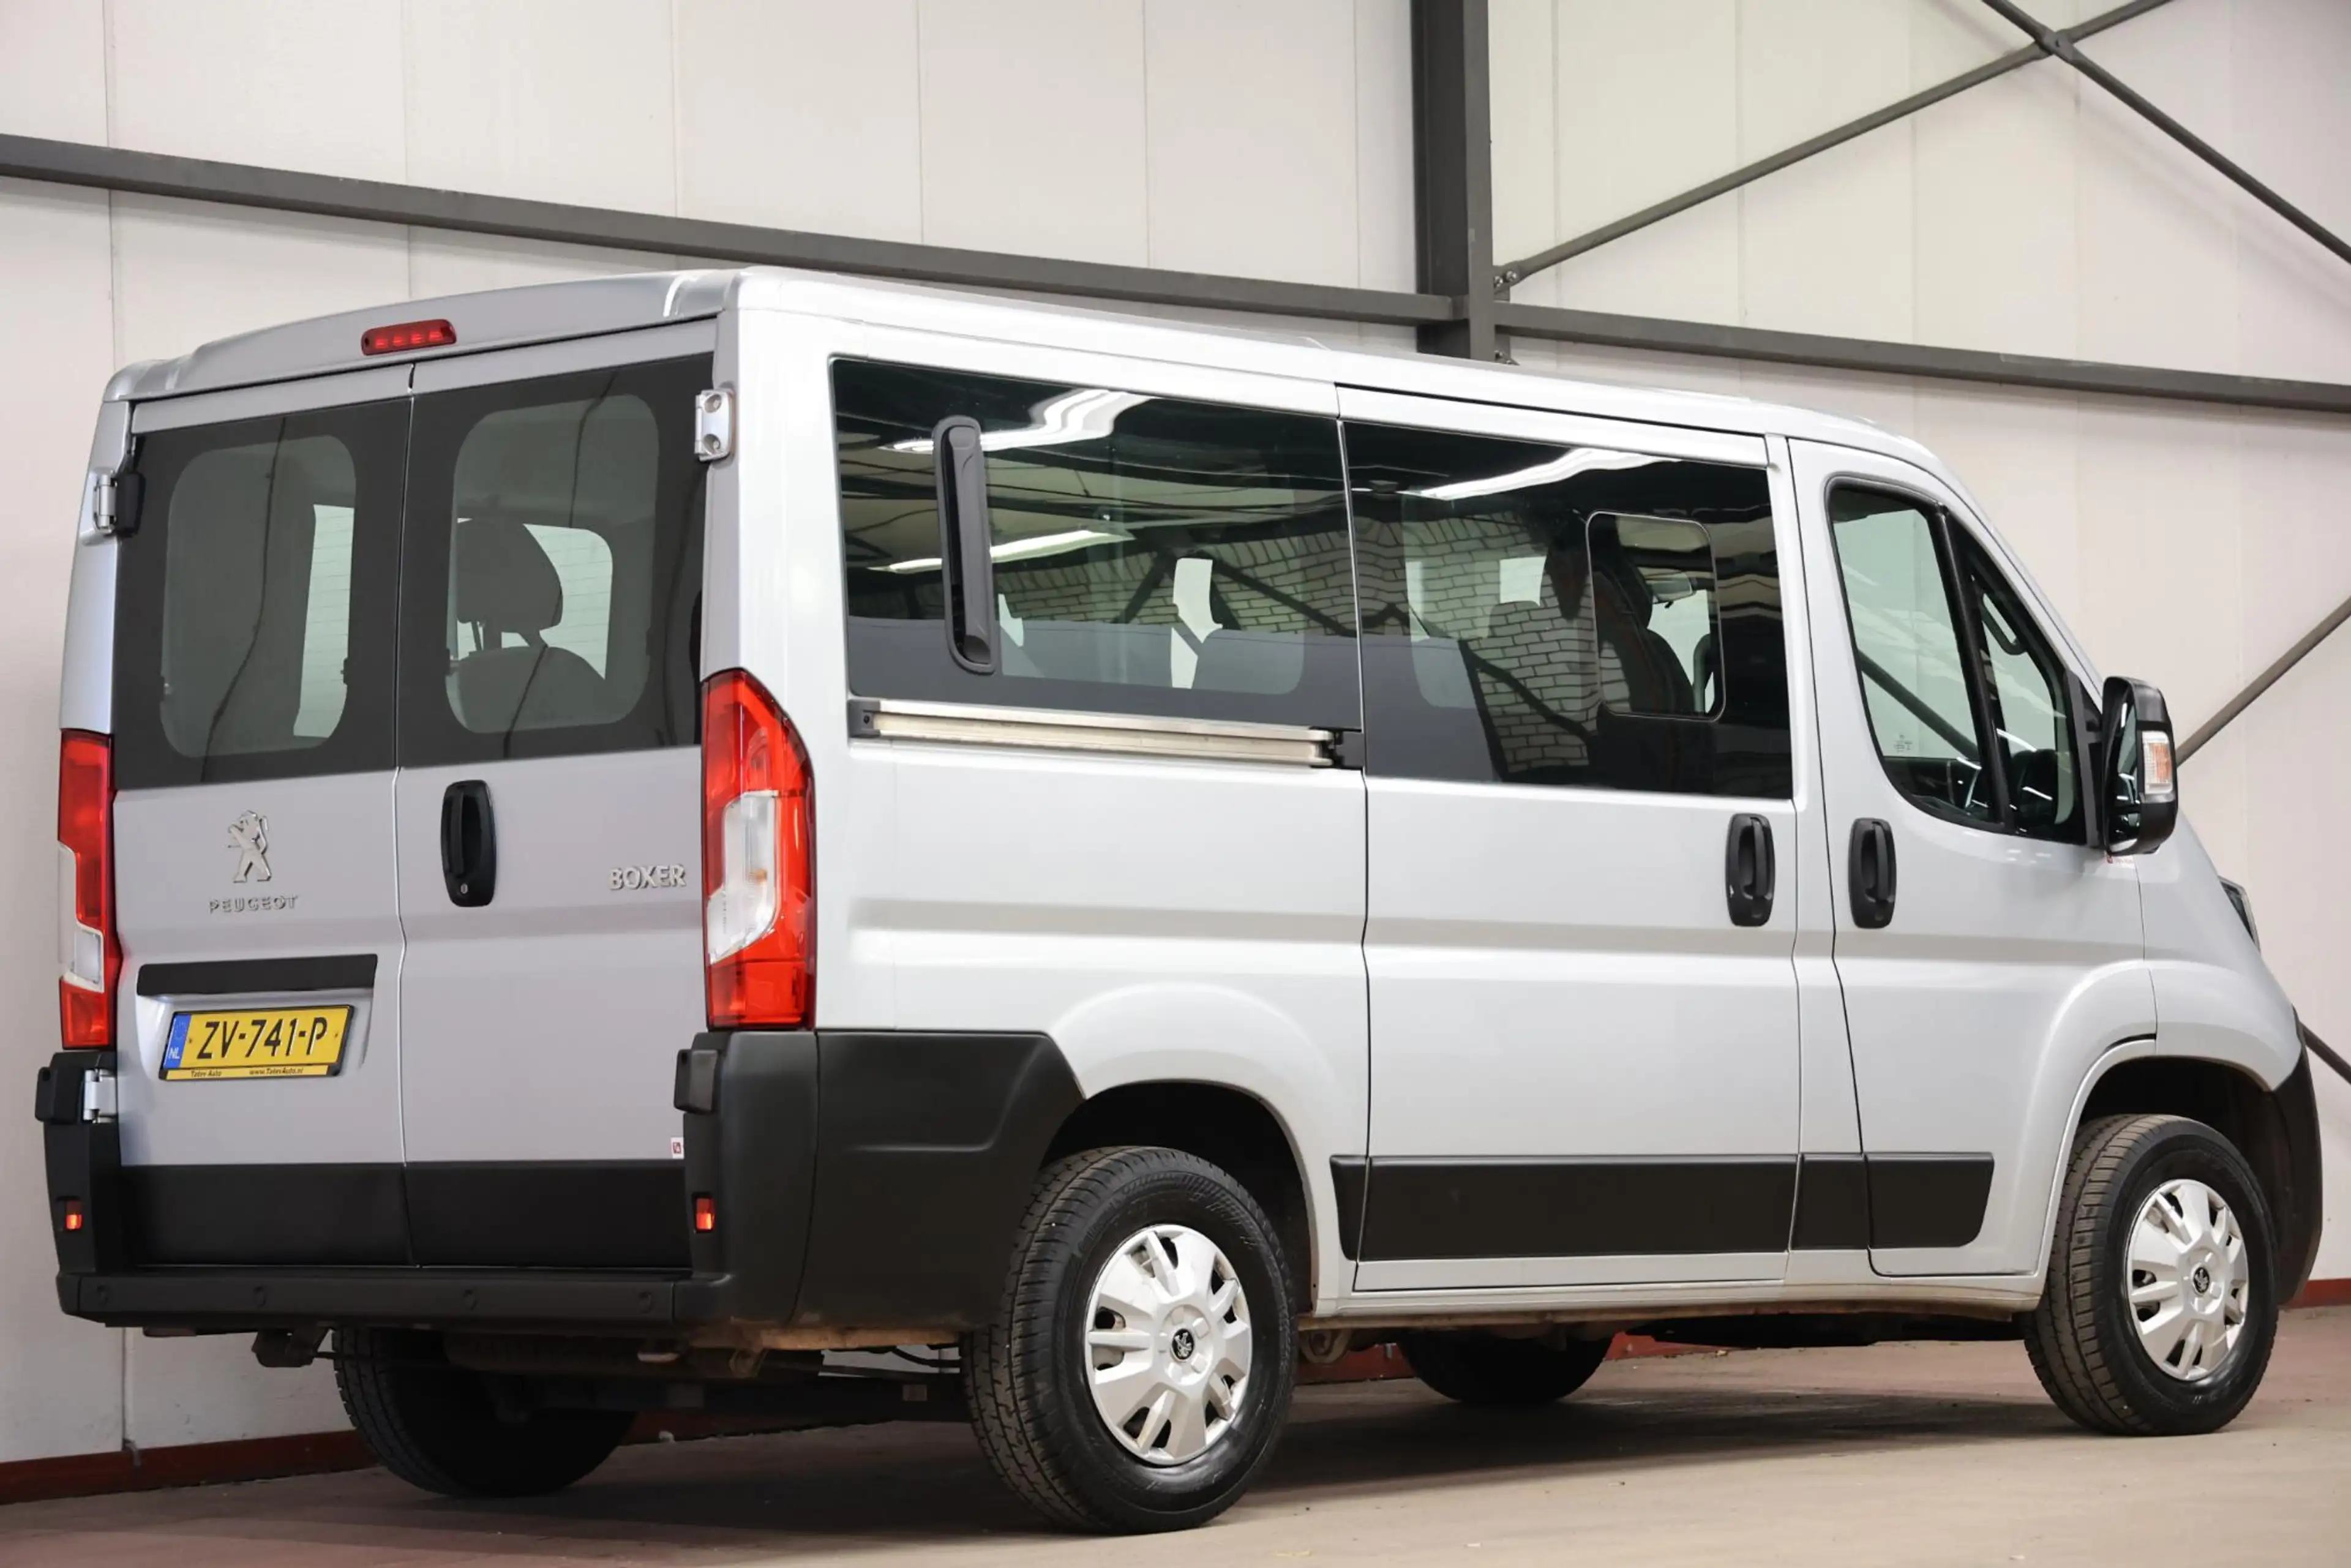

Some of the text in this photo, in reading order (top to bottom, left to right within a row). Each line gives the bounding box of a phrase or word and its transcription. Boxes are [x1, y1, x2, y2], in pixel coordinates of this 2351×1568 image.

[610, 864, 686, 890] BOXER
[209, 895, 298, 913] PEUGEOT
[197, 1016, 328, 1059] ZV-741-P
[168, 1046, 180, 1059] NL
